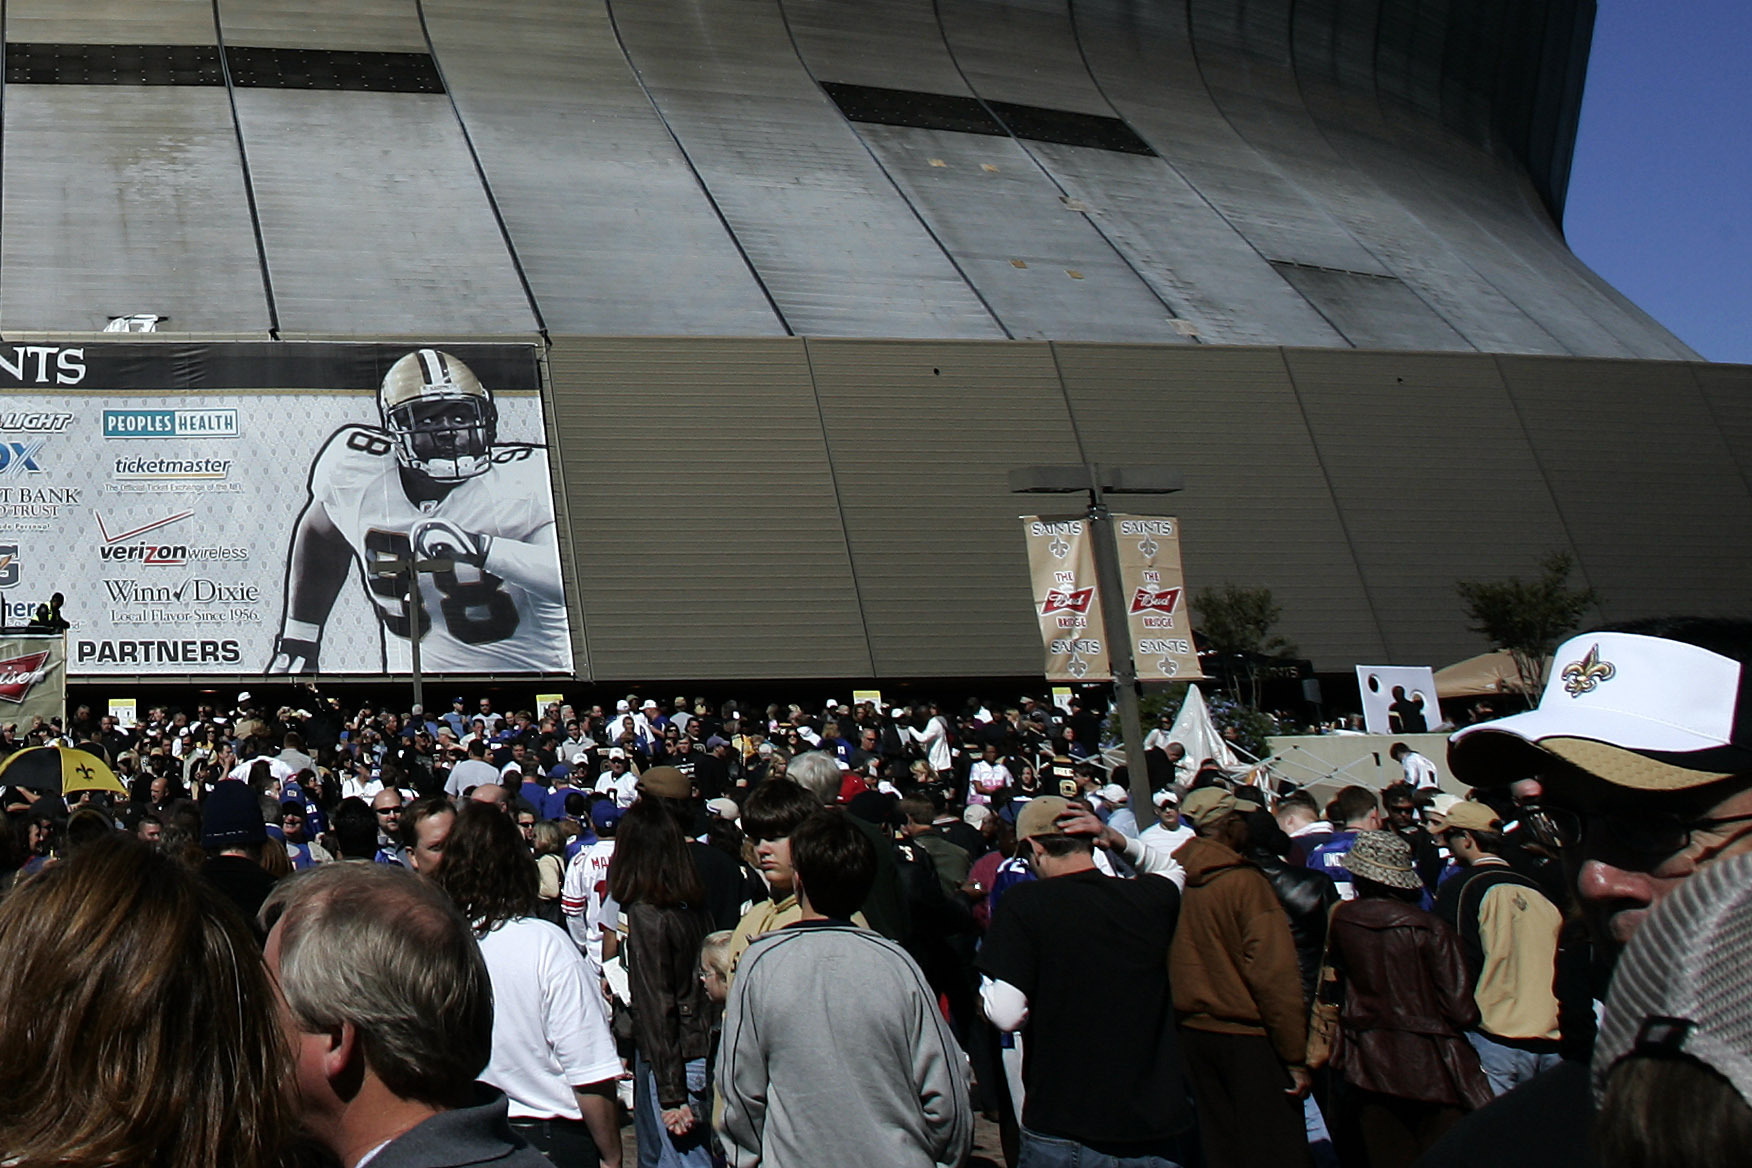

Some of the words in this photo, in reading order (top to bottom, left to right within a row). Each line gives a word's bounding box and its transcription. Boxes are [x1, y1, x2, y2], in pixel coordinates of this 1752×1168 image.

[3, 413, 71, 430] LIGHT
[108, 415, 171, 431] PEOPLES
[179, 415, 233, 431] HEALTH
[115, 457, 231, 473] ticketmaster
[19, 488, 80, 503] BANK
[12, 505, 60, 516] TRUST
[1032, 521, 1082, 536] SAINTS
[1122, 521, 1172, 535] SAINTS
[100, 541, 187, 563] verizon
[187, 545, 247, 560] wireless
[1055, 572, 1073, 582] THE
[1144, 571, 1159, 581] THE
[104, 579, 171, 602] Winn
[193, 579, 259, 602] Dixie
[1050, 593, 1084, 607] Bud
[1139, 593, 1170, 607] Bud
[111, 609, 146, 622] Local
[151, 609, 190, 622] Flavor
[193, 610, 226, 622] Since
[1058, 617, 1086, 628] BRIDGE
[1144, 617, 1173, 628] BRIDGE
[78, 641, 240, 663] PARTNERS
[1051, 640, 1100, 654] SAINTS
[1140, 640, 1189, 653] SAINTS
